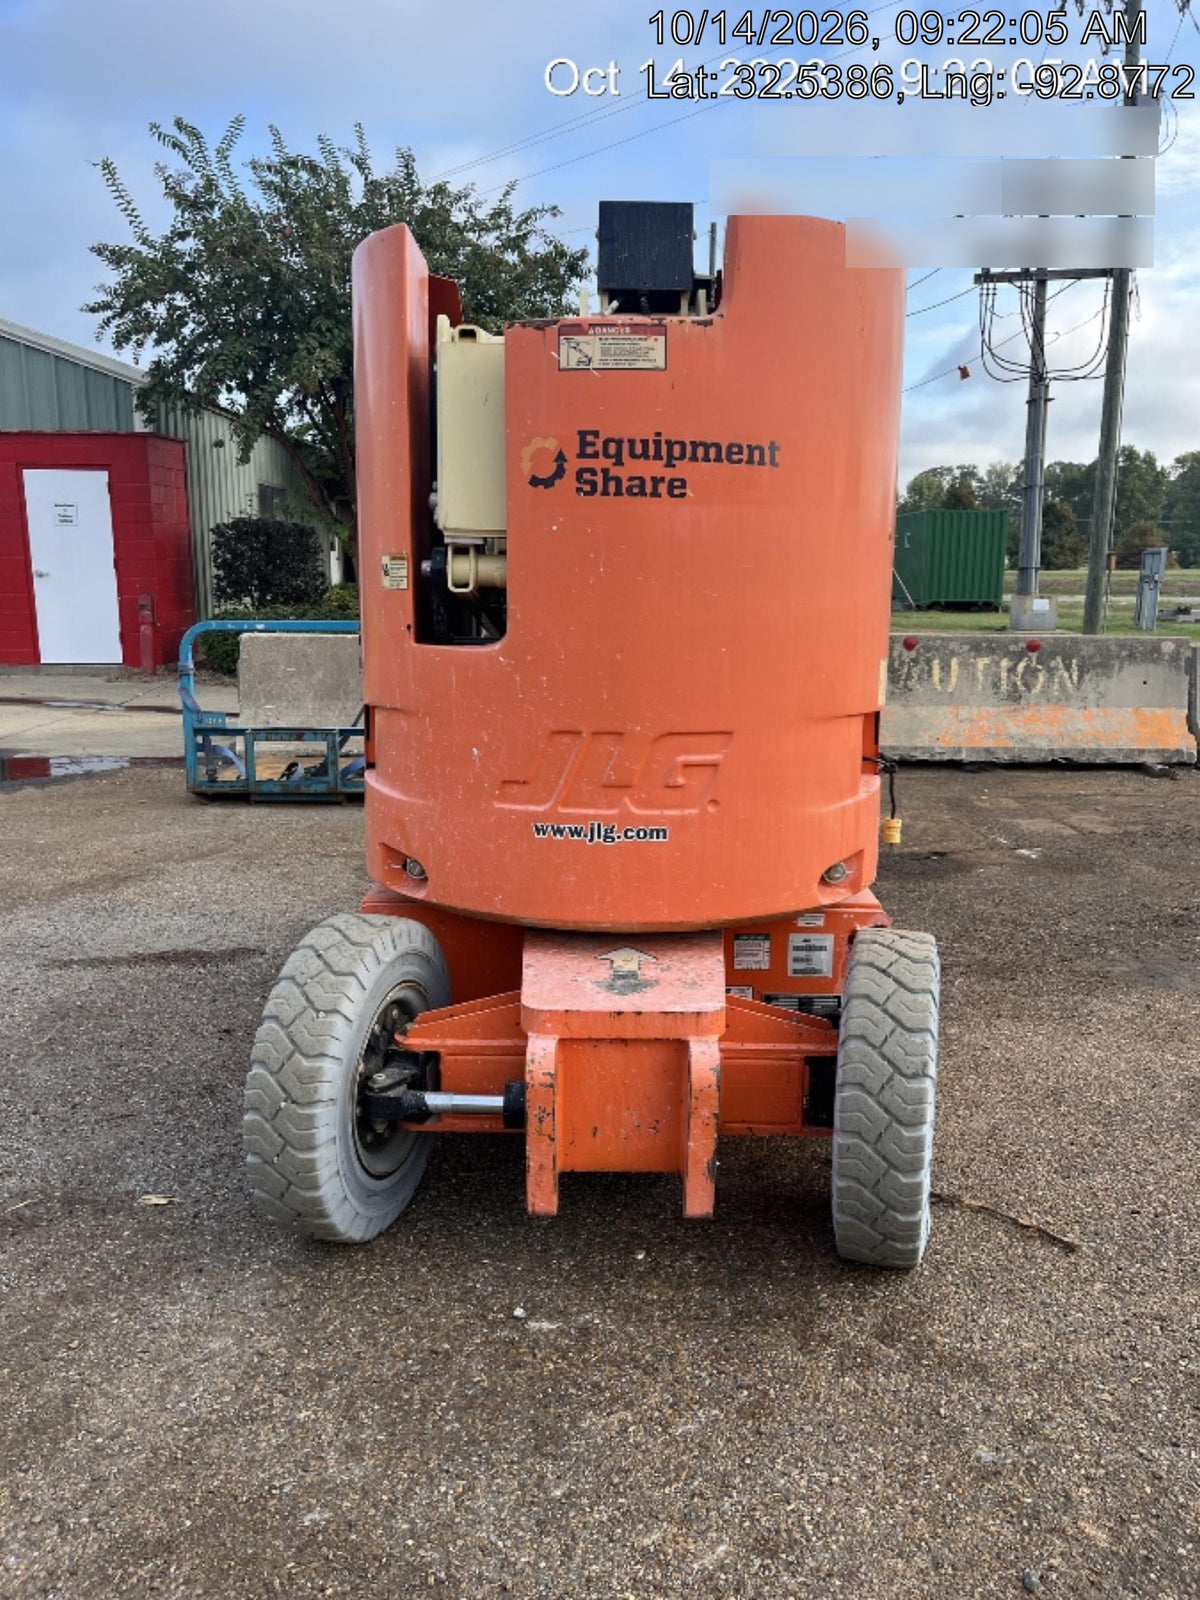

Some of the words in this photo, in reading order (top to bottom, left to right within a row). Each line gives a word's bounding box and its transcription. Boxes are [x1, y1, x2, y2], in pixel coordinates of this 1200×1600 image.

[576, 430, 780, 468] Equipment
[575, 467, 687, 498] Share
[905, 656, 1079, 696] UTION
[494, 730, 734, 815] JLG
[533, 822, 669, 844] www.jlg.com
